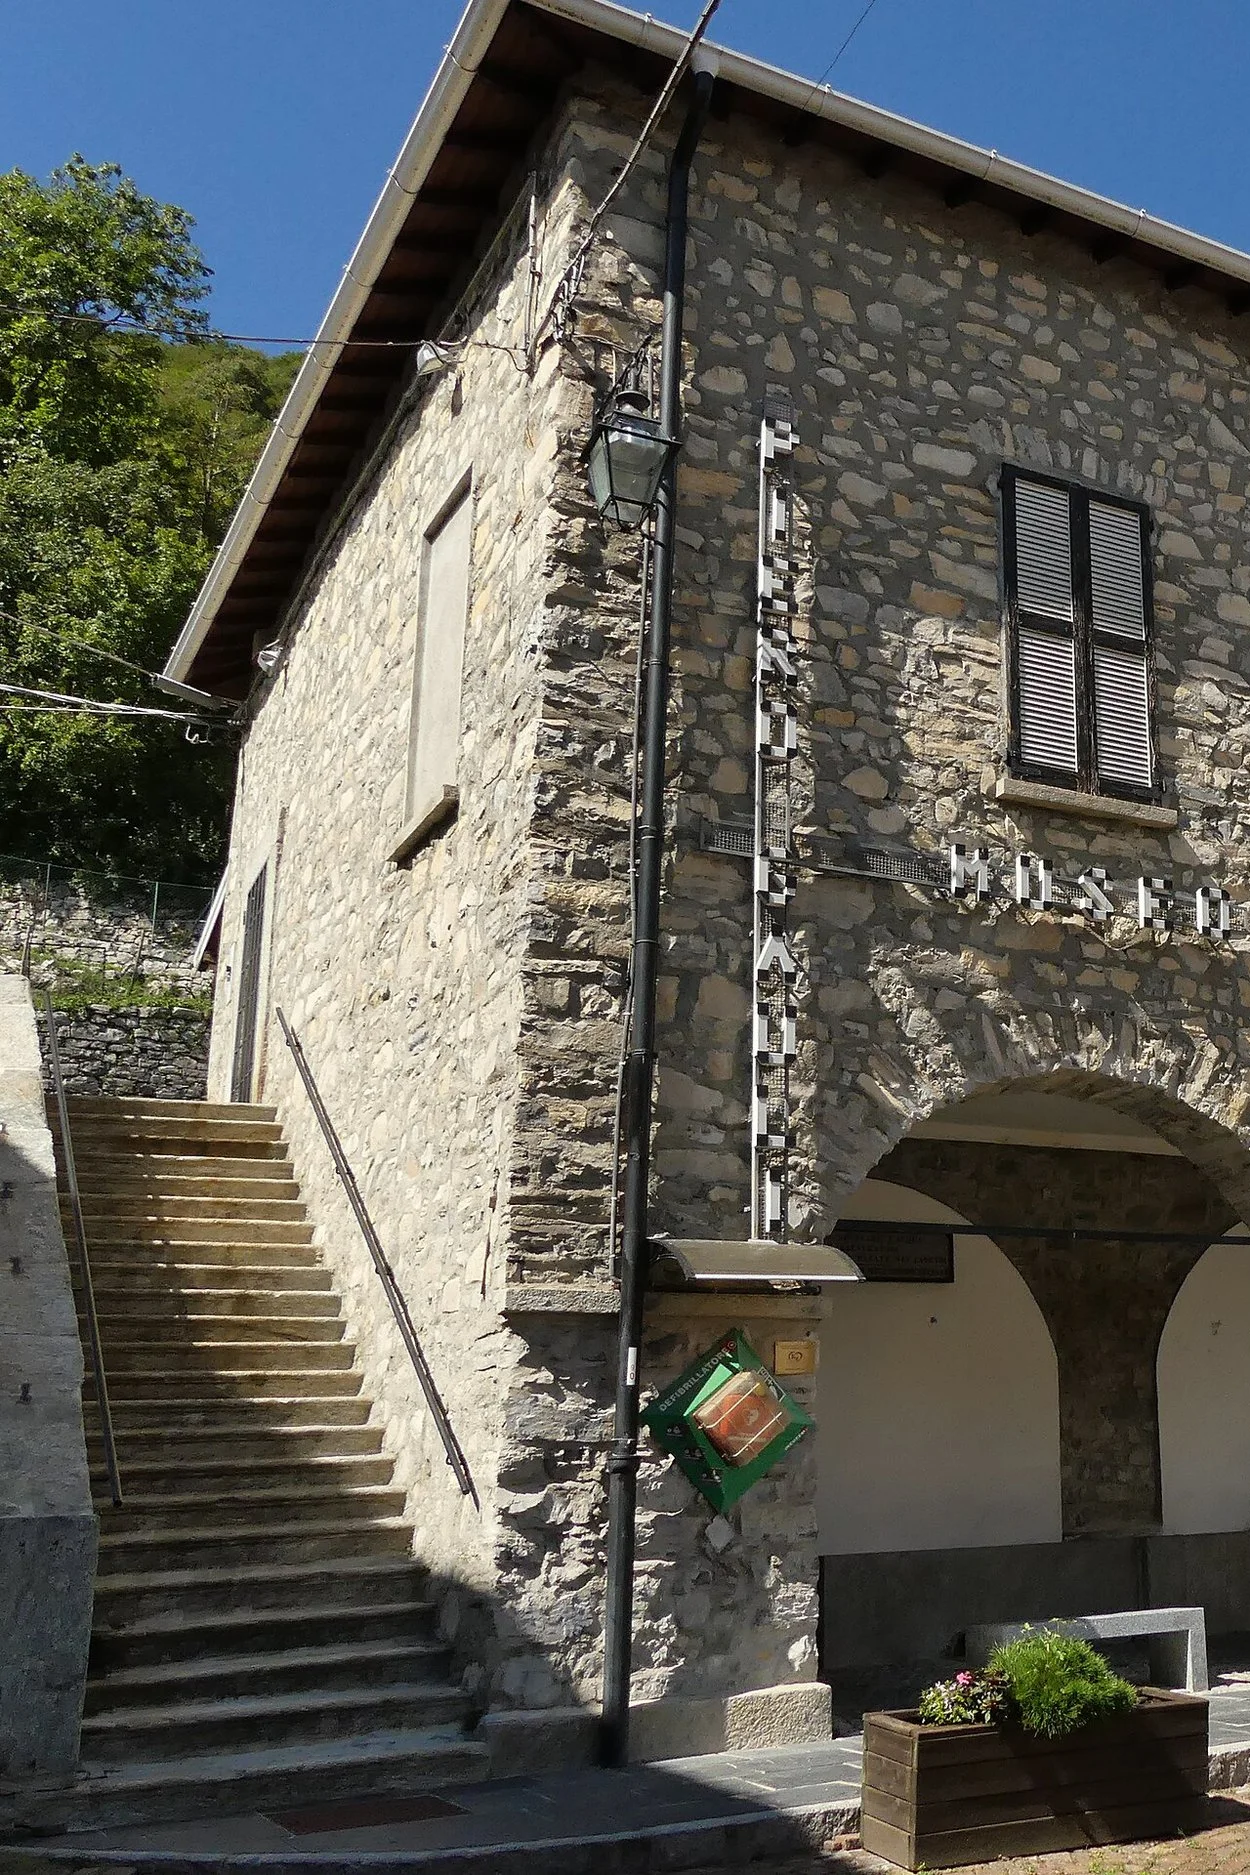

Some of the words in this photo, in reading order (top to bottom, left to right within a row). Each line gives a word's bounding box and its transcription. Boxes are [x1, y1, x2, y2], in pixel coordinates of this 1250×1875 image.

[759, 418, 799, 759] PIERO
[951, 844, 1230, 939] MUSEO
[659, 1346, 730, 1412] DEFIBRILLATORE
